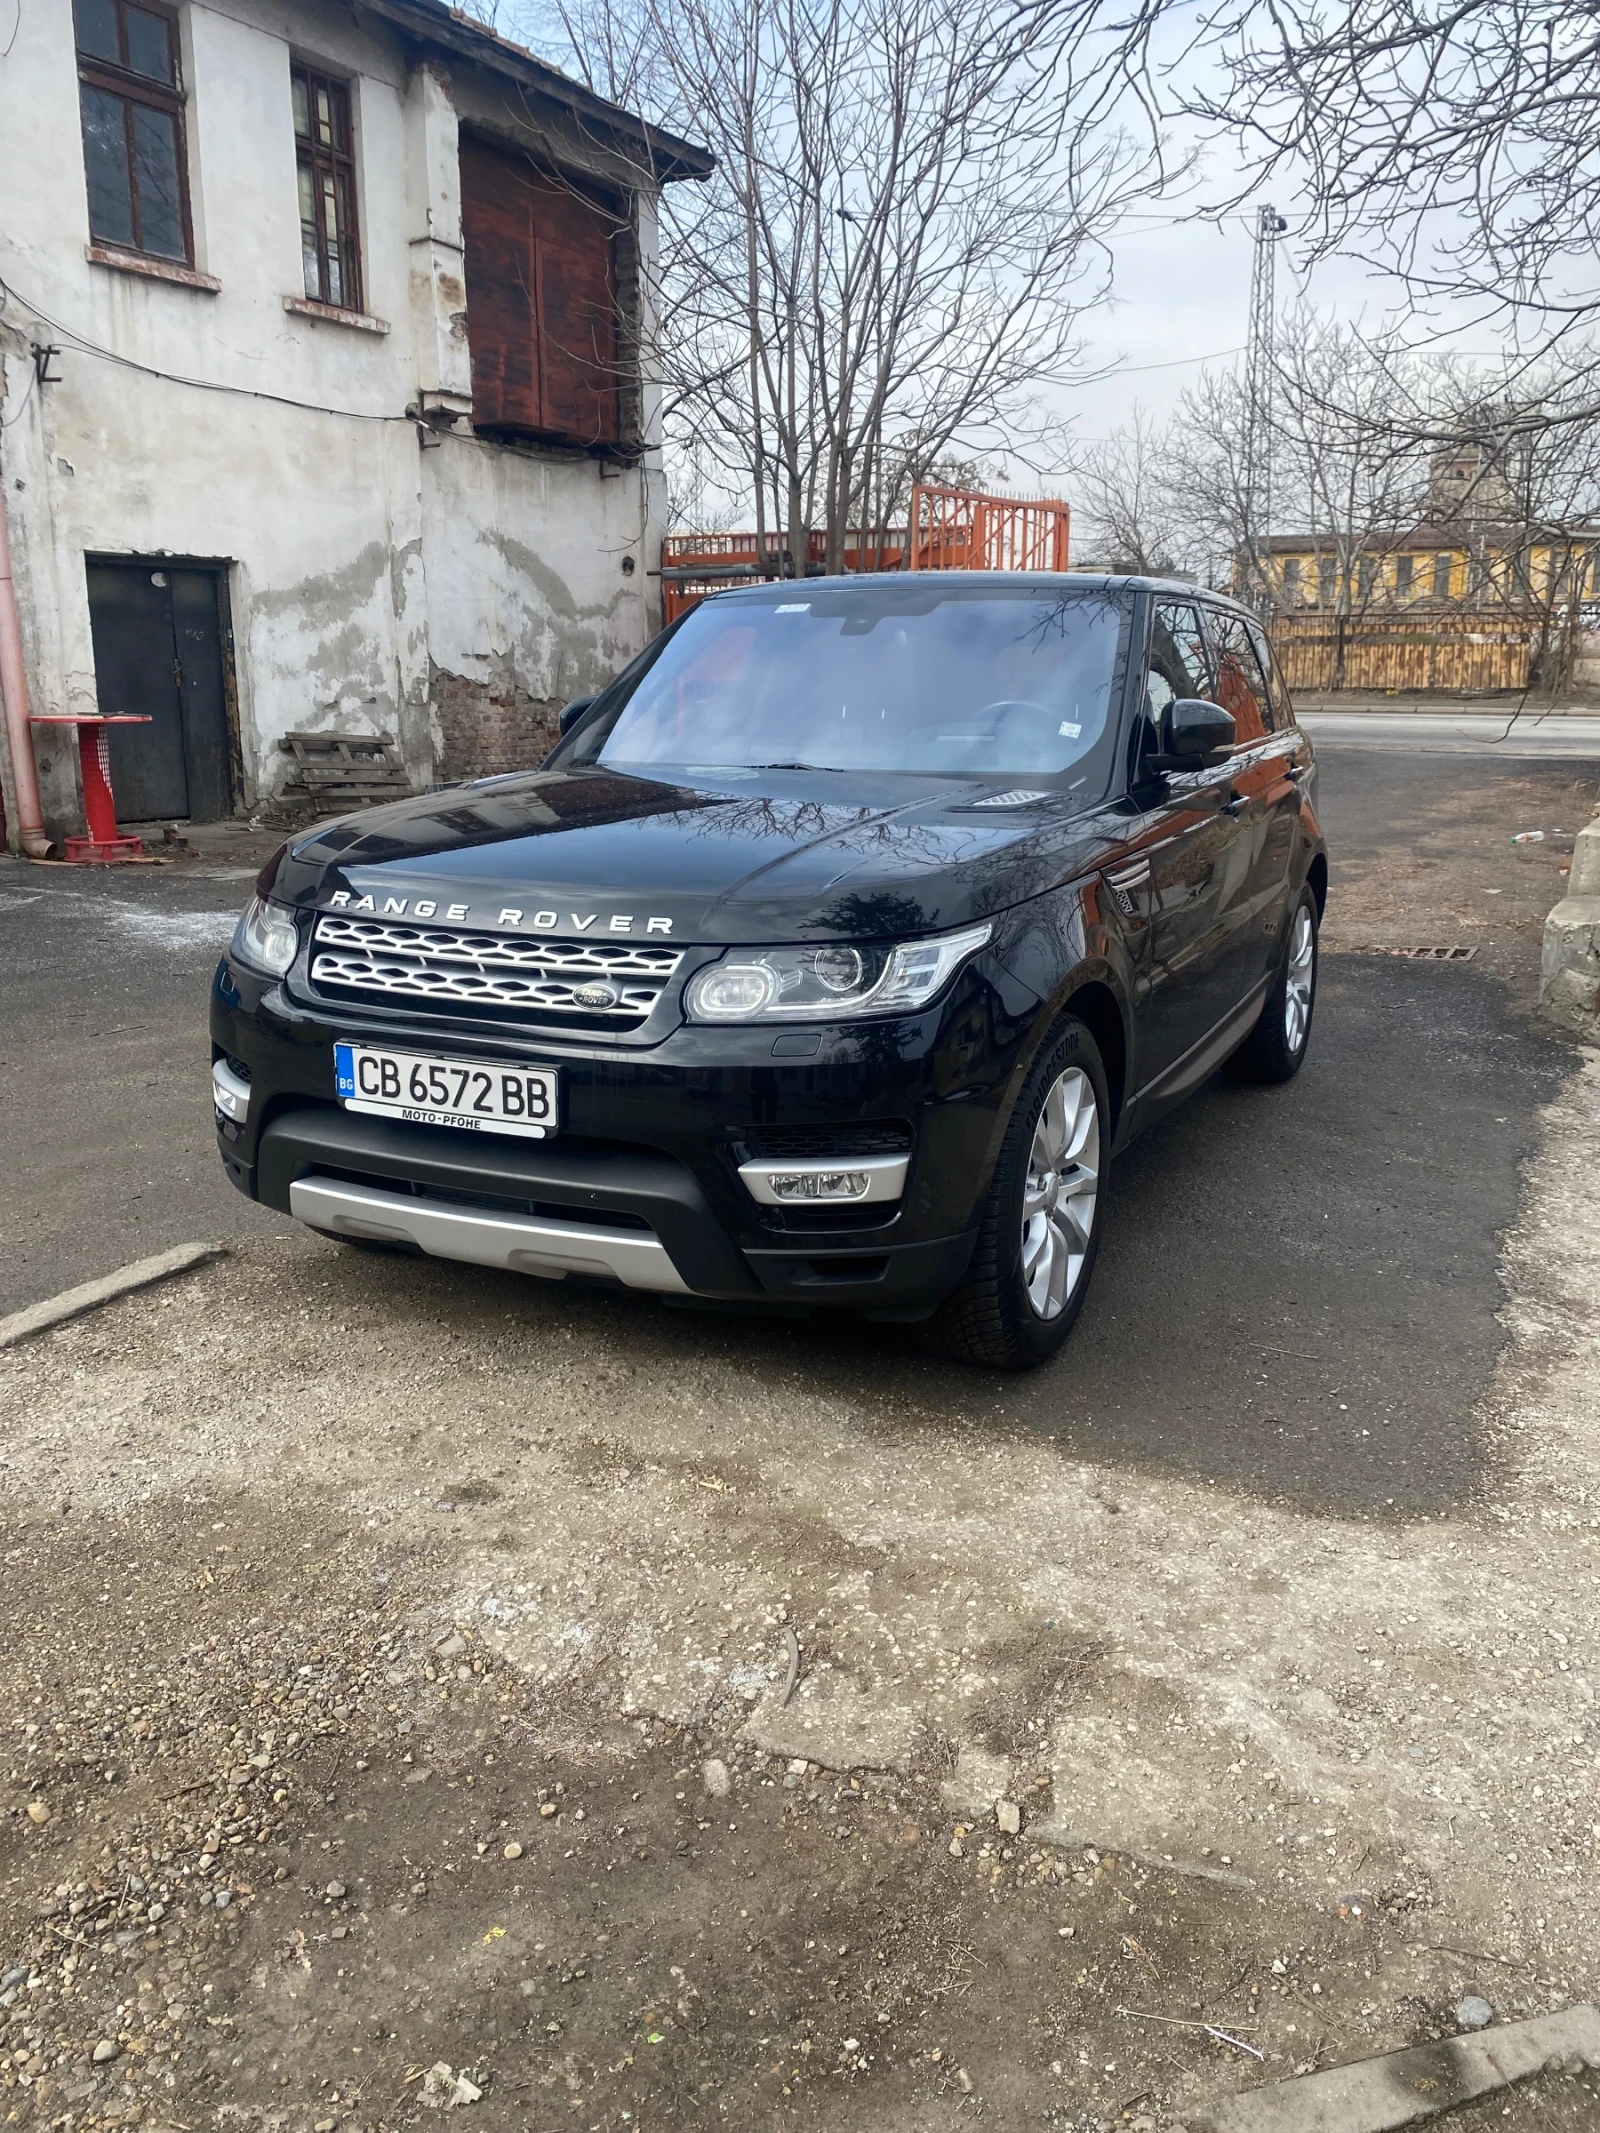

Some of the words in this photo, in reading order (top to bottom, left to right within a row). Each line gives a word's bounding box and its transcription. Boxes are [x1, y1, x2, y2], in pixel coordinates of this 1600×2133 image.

[330, 890, 469, 921] RANGE
[498, 908, 674, 935] ROVER
[582, 995, 609, 1005] ROVER
[339, 1077, 353, 1090] BG
[358, 1056, 401, 1098] CB
[409, 1063, 494, 1113] 6572
[501, 1074, 550, 1119] BB
